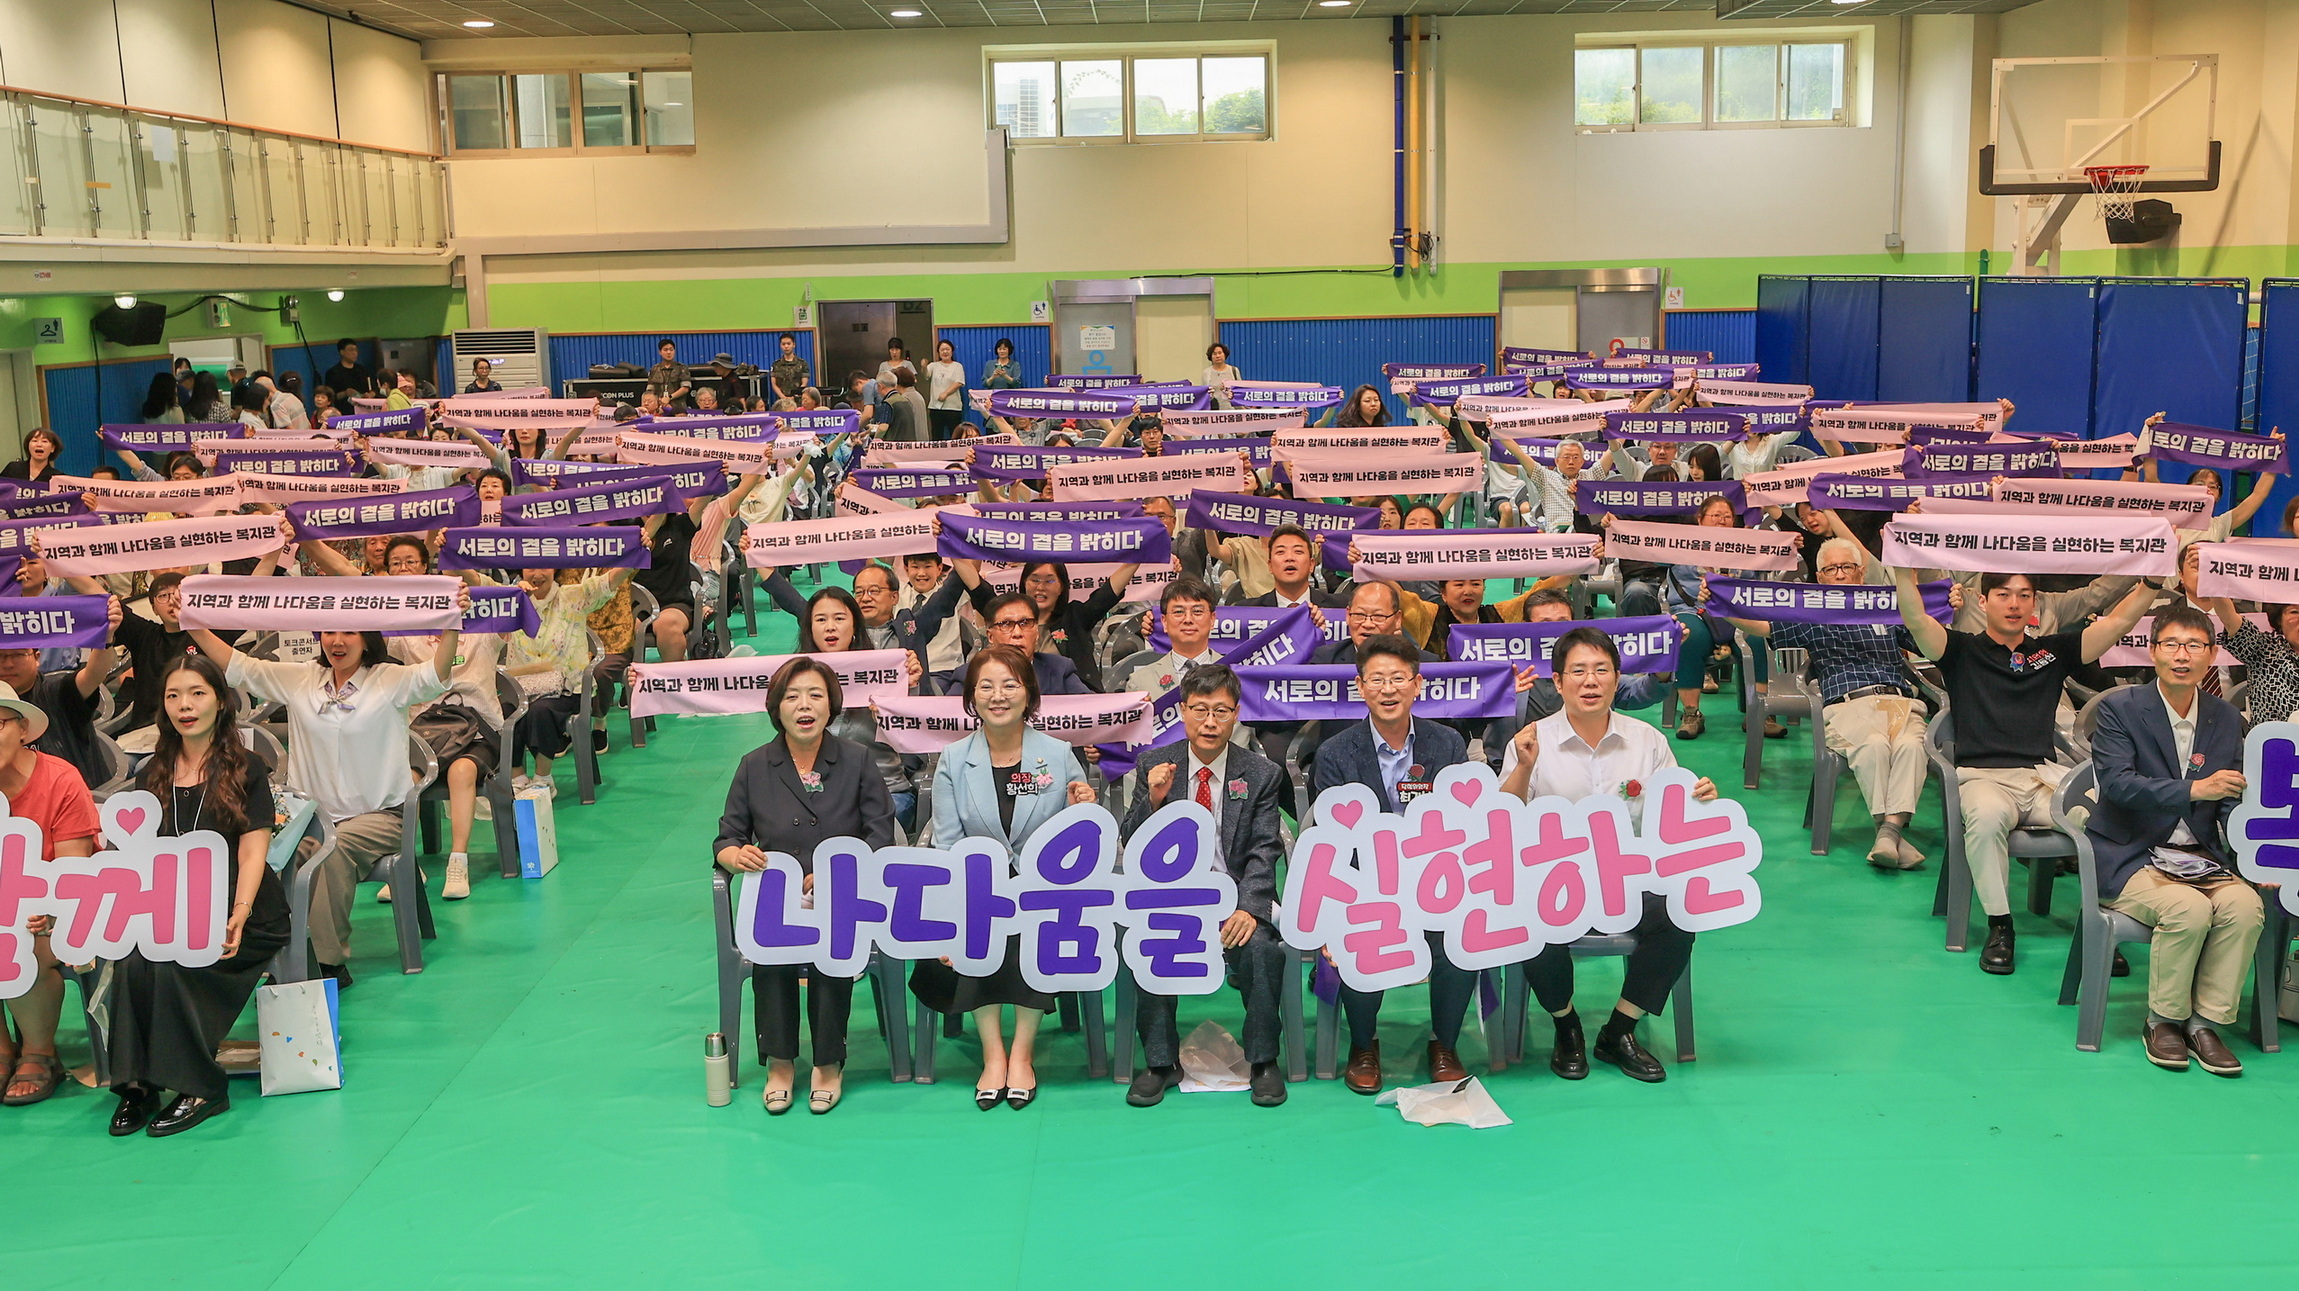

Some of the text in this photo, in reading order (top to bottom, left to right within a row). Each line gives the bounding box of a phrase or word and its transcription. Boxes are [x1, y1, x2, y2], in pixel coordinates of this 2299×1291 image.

[1578, 374, 1663, 383] 서로의 곁을 밝히다
[1718, 368, 1746, 378] 밝히다
[1244, 392, 1328, 402] 서로의 곁을 밝히다
[1430, 382, 1514, 397] 서로의 밝히다
[1007, 397, 1118, 412] 서로의 곁을 밝히다
[1161, 392, 1195, 406] 밝히다
[447, 408, 472, 418] 지역과
[474, 409, 492, 418] 함께
[495, 409, 530, 418] 나다움을
[531, 409, 564, 418] 실현하는
[566, 408, 592, 418] 복지관
[1166, 412, 1276, 426] 지역과 함께 나다움을 실현하는
[1762, 412, 1797, 424] 밝히다
[336, 414, 412, 430] 서로의 밝히다
[813, 416, 846, 428] 밝히다
[1493, 415, 1570, 430] 지역과 함께 나다움을
[1620, 420, 1730, 434] 서로의 곁을 밝히다
[1819, 419, 1906, 431] 지역과 함께 나다움을
[120, 432, 190, 444] 서로의 곁을
[722, 426, 762, 440] 밝히다
[1278, 436, 1440, 448] 지역과 함께 나다움을 실현하는 복지관
[2082, 442, 2122, 454] 실현하는
[2190, 436, 2282, 462] 곁을 밝히다
[395, 448, 442, 458] 함께 나다움을
[622, 441, 763, 463] 지역과 함께 나다움을 실현하는 복지관
[230, 458, 340, 474] 서로의 곁을 밝히다
[991, 454, 1037, 470] 서로의
[1922, 450, 2059, 472] 서로의 곁을 밝히다
[871, 474, 950, 490] 서로의 곁을
[1059, 466, 1236, 488] 지역과 함께 나다움을 실현하는 복지관
[1299, 467, 1475, 484] 지역과 함께 나다움을 실현하는 복지관
[266, 480, 401, 494] 함께 나다움을 실현하는 복지관
[1784, 478, 1806, 490] 함께
[520, 486, 664, 520] 서로의 곁을 밝히다
[1592, 490, 1673, 506] 서로의 곁을
[2001, 490, 2206, 514] 지역과 함께 나다움을 실현하는 복지관
[303, 498, 456, 528] 서로의 곁을 밝히다
[1210, 502, 1356, 530] 서로의 밝히다
[44, 526, 276, 560] 지역과 함께 나다움을 실현하는 복지관
[752, 524, 930, 550] 지역과 함께 나다움을 실현하는
[965, 528, 1143, 552] 서로의 곁을 밝히다
[1612, 534, 1792, 556] 지역과 함께 나다움을 실현하는 복지관
[1894, 532, 2167, 554] 지역과 함께 나다움을 실현하는 복지관
[458, 538, 625, 557] 서로의 곁을 밝히다
[1362, 546, 1592, 565] 지역과 함께 나다움을 실현하는 복지관
[1145, 570, 1178, 584] 복지관
[2209, 562, 2289, 582] 지역과 함께
[187, 594, 451, 611] 지역과 함께 나다움을 실현하는 복지관
[1731, 586, 1846, 610] 서로의 곁을
[1460, 638, 1532, 662] 서로의
[638, 670, 898, 694] 지역과 함께 복지관
[1264, 680, 1338, 703] 서로의
[878, 708, 1143, 732] 지역과 함께 복지관
[1011, 773, 1032, 782] 의장
[1006, 783, 1038, 796] 황선희
[1297, 784, 1746, 976] 실현하는
[753, 817, 1222, 976] 나다움을
